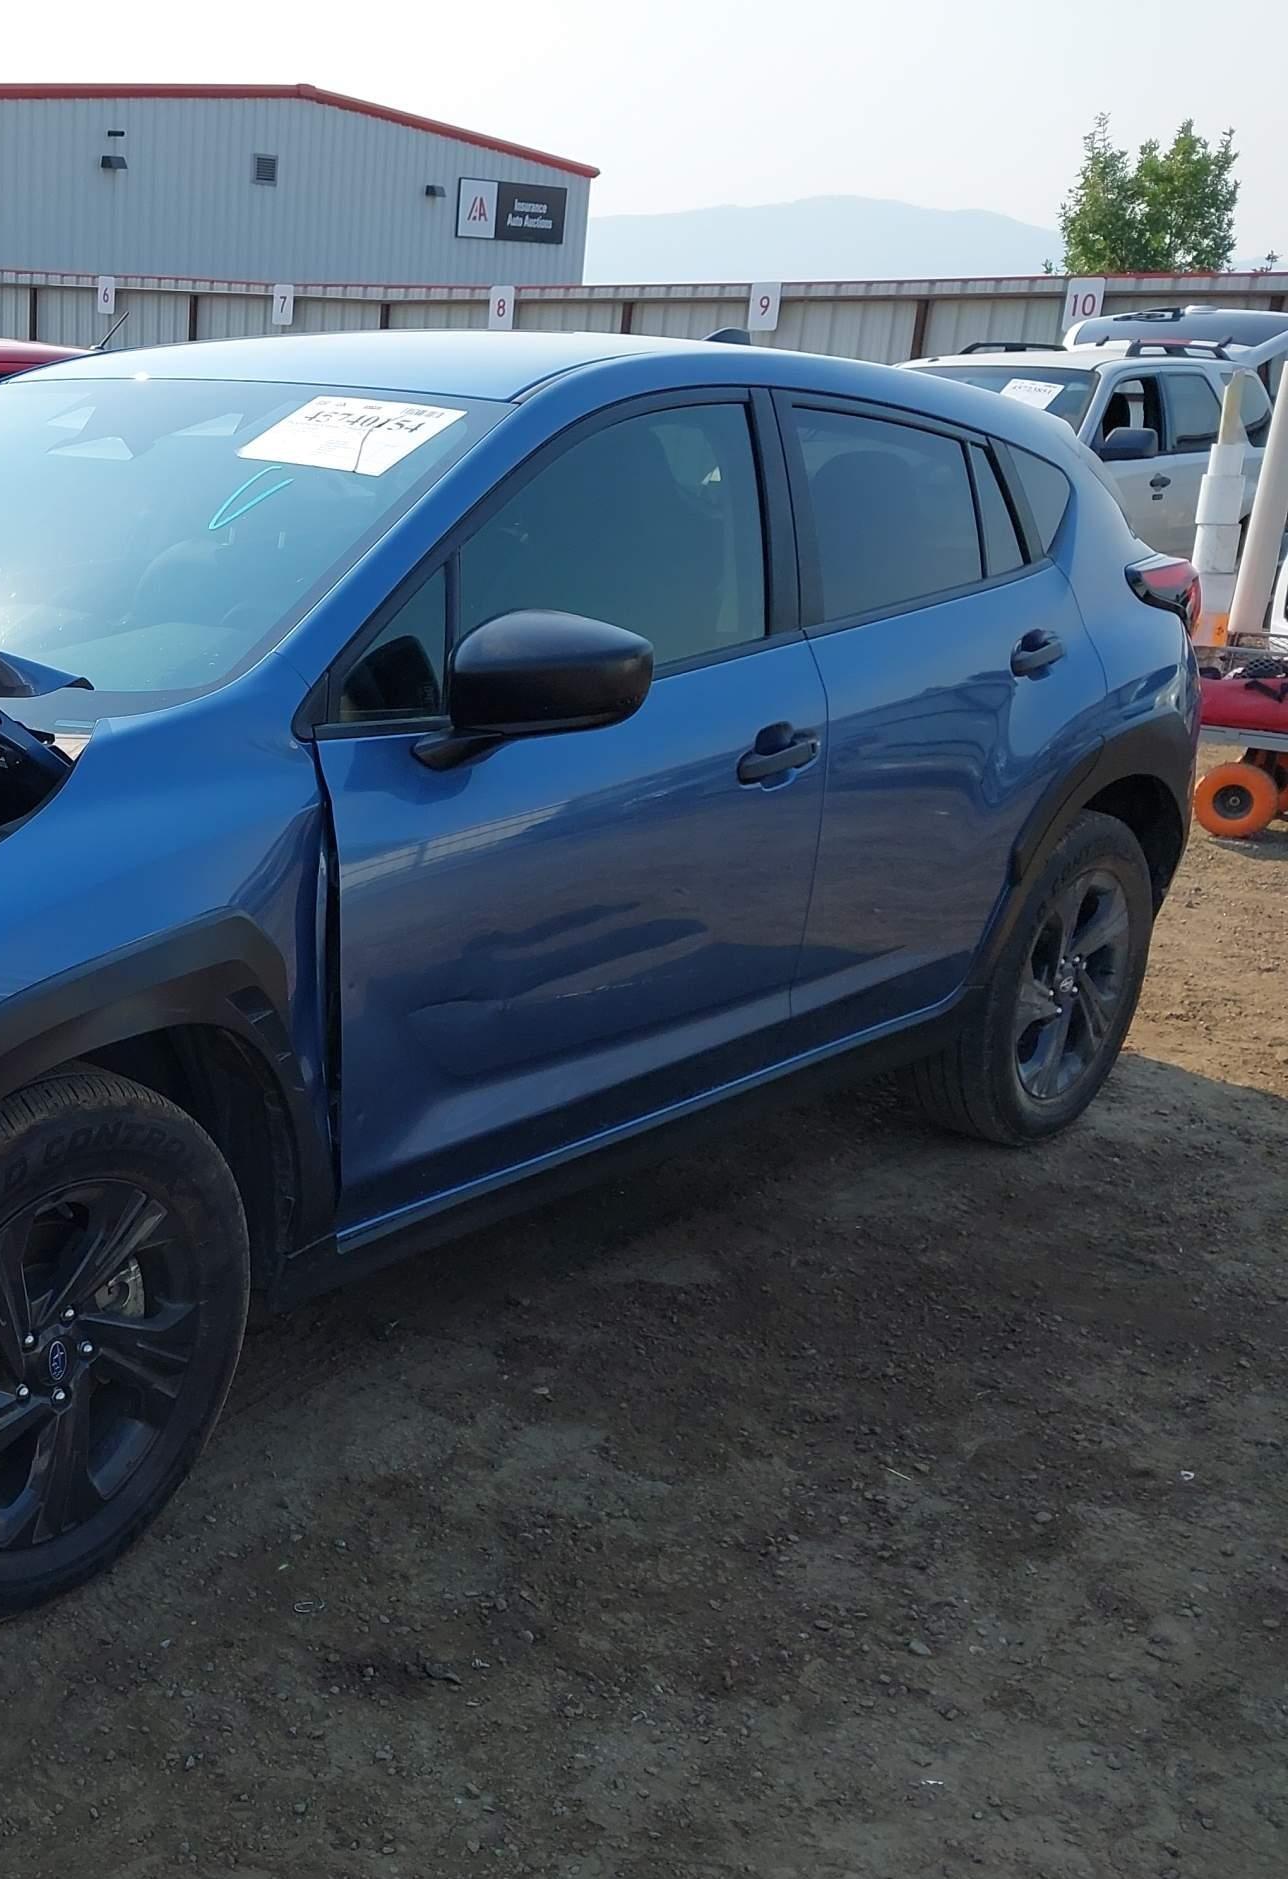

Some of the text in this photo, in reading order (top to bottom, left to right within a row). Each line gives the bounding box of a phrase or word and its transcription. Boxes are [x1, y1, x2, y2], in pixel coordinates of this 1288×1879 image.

[514, 199, 548, 214] Insurance
[507, 213, 553, 229] Auto Auctions
[102, 287, 109, 303] 6
[279, 295, 288, 313] 7
[496, 298, 506, 318] 8
[759, 295, 770, 316] 9
[1071, 293, 1096, 317] 10
